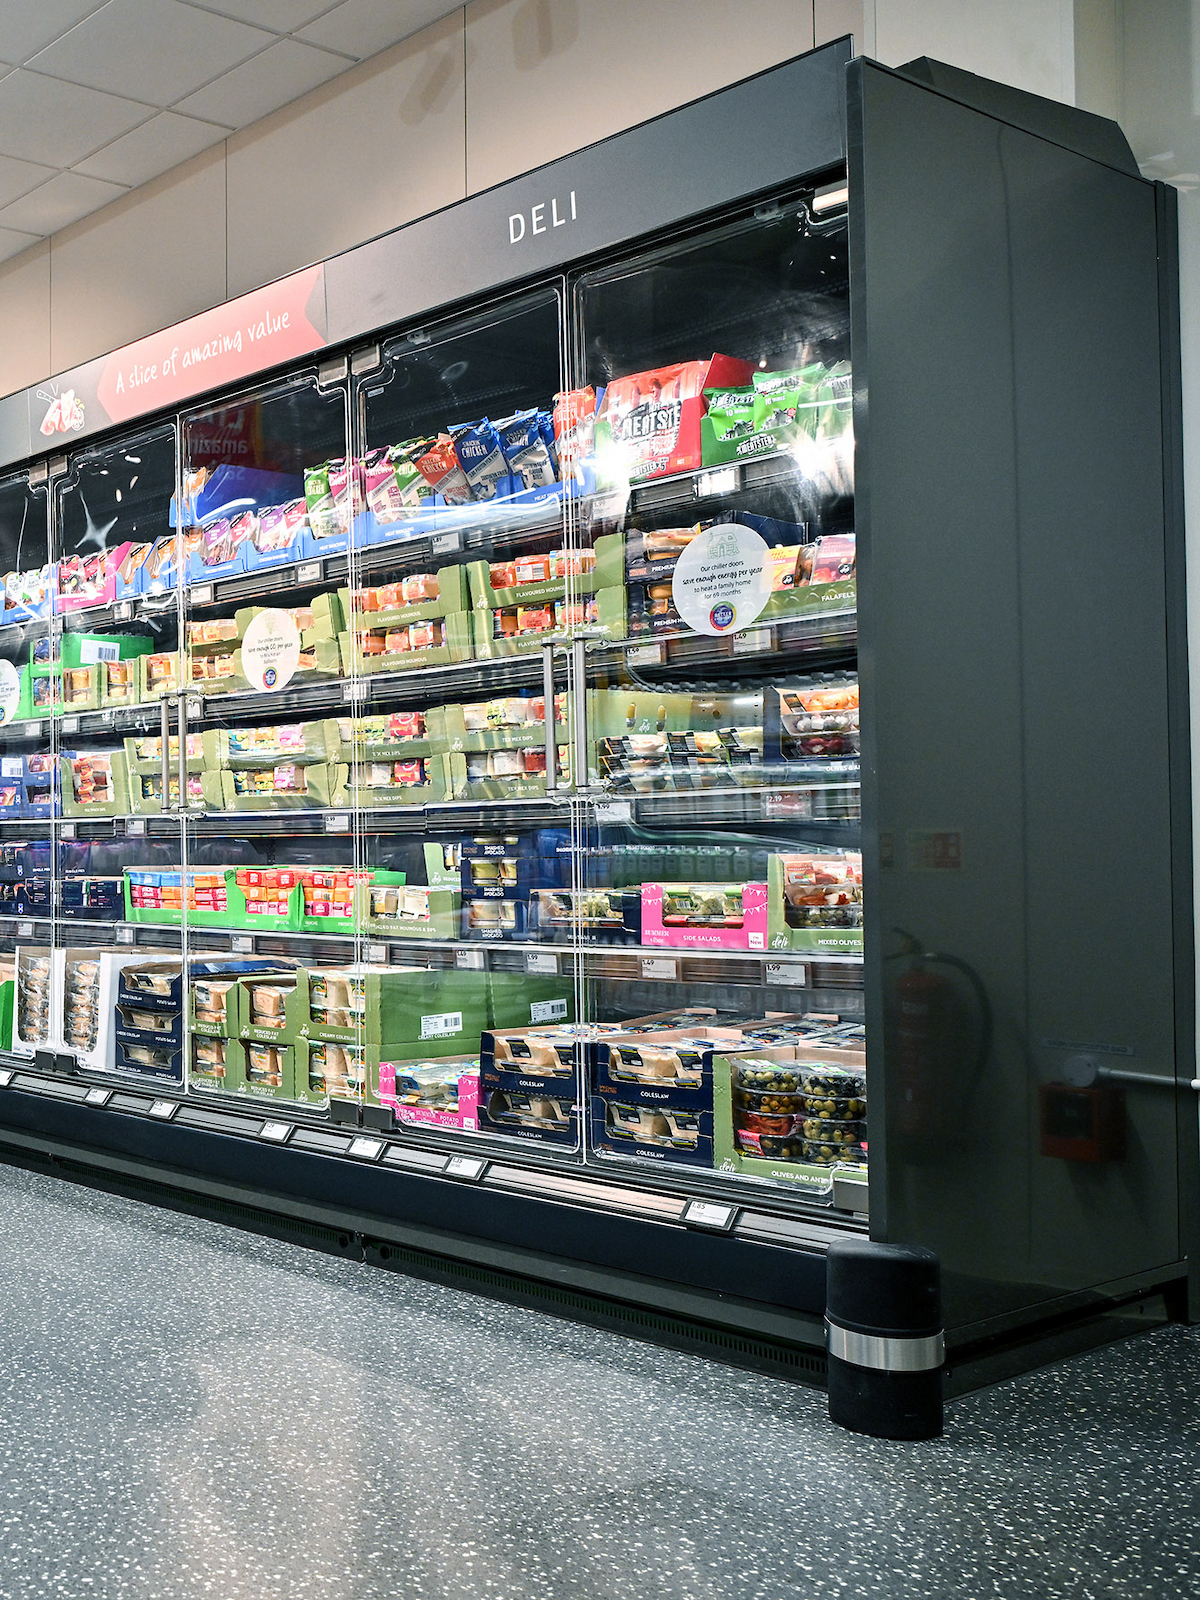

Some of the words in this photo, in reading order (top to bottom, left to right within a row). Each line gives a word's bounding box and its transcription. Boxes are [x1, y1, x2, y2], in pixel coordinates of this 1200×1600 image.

[508, 190, 577, 245] DELI
[116, 371, 125, 394] A
[129, 364, 158, 390] slice
[162, 347, 179, 376] of
[182, 330, 242, 369] amazing
[247, 310, 291, 342] value
[461, 445, 488, 459] CHICKEN
[421, 461, 449, 474] CHICKEN
[651, 564, 676, 572] PREMIUM
[711, 562, 728, 570] chiller
[695, 573, 717, 583] enough
[717, 571, 738, 581] energy
[738, 569, 748, 578] per
[749, 566, 763, 575] year
[718, 581, 735, 590] family
[735, 579, 751, 587] home
[515, 588, 545, 598] FLAVOURED
[720, 589, 742, 597] months
[821, 591, 855, 602] FALAFELS
[654, 619, 677, 627] PREMIUM
[682, 934, 697, 942] SIDE
[697, 935, 721, 943] SALADS
[771, 935, 789, 948] deli
[818, 938, 838, 946] MIXED
[838, 938, 861, 946] OLIVES
[642, 959, 654, 967] 1.49
[766, 963, 780, 971] 1.99
[519, 1079, 545, 1088] COLESLAW
[640, 1090, 670, 1100] COLESLAW
[440, 1115, 459, 1123] POTATO
[517, 1130, 543, 1139] COLESLAW
[635, 1149, 665, 1159] COLESLAW
[771, 1170, 794, 1180] OLIVES
[690, 1202, 706, 1210] 1.85
